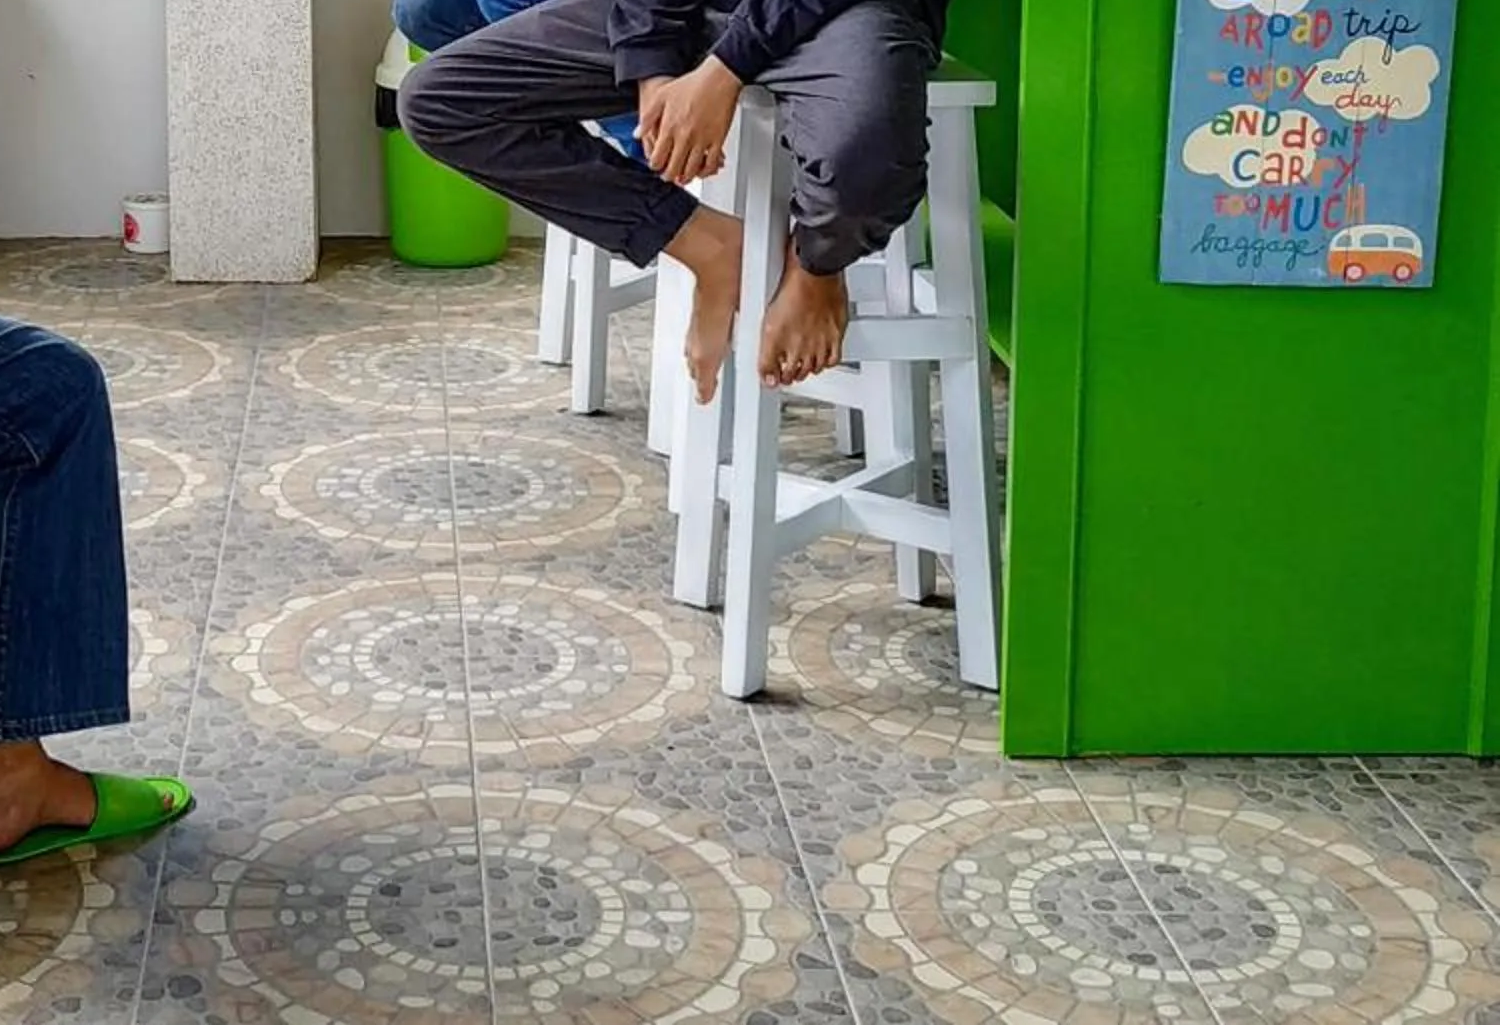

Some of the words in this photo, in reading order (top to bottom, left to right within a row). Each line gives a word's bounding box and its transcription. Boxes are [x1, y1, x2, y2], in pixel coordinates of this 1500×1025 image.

[1344, 7, 1421, 65] trip
[1321, 65, 1370, 85] each
[1335, 82, 1403, 134] day
[1262, 183, 1367, 235] MUCH
[1190, 223, 1325, 272] baggage
